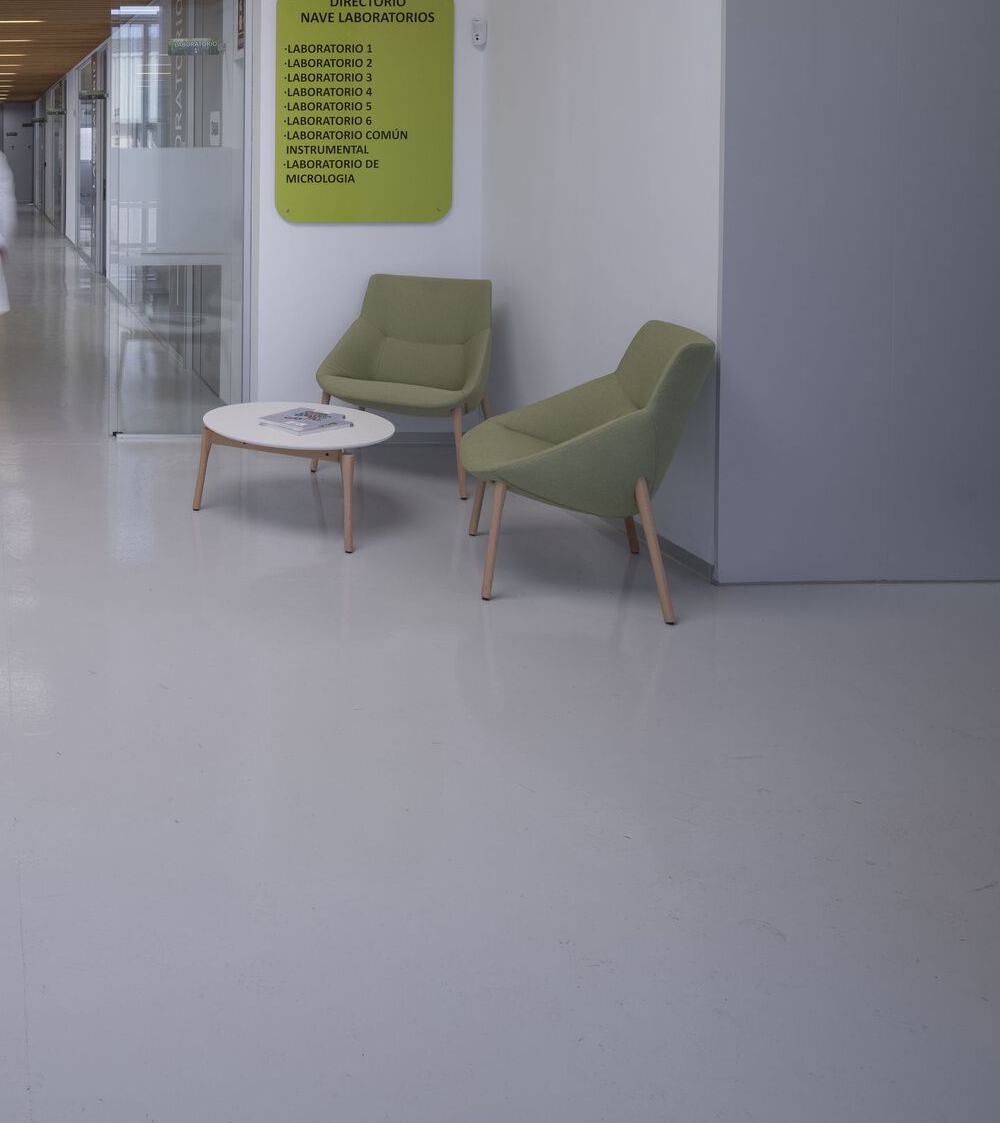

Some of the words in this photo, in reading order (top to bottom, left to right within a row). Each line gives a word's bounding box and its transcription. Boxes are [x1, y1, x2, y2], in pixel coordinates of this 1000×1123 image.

[300, 11, 335, 24] NAVE
[338, 11, 435, 24] LABORATORIOS
[174, 40, 218, 48] LABORATORIO
[366, 43, 373, 54] 1
[366, 58, 373, 69] 2
[366, 72, 373, 83] 3
[366, 86, 373, 97] 4
[366, 101, 373, 112] 5
[366, 115, 373, 126] 6
[365, 127, 408, 141] COMÚN
[286, 144, 370, 155] INSTRUMENTAL
[365, 159, 380, 170] DE
[286, 173, 356, 184] MICROLOGIA
